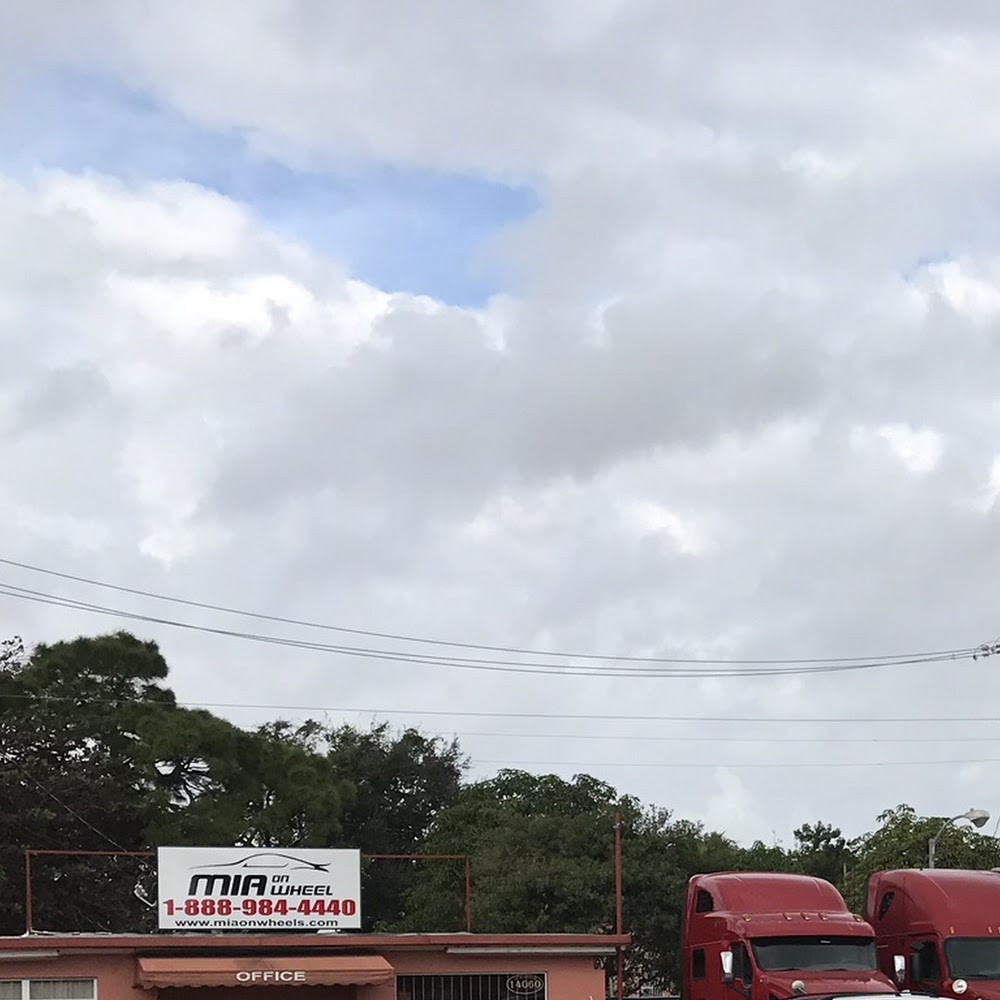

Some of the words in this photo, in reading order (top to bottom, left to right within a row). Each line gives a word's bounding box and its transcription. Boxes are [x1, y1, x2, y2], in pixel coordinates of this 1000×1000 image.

[188, 874, 268, 896] MIA
[270, 885, 333, 896] WHEEL
[163, 898, 357, 916] 1-888-984-4440
[175, 918, 339, 927] www.miaonwheels.com
[236, 971, 306, 982] OFFICE
[510, 980, 542, 989] 14060
